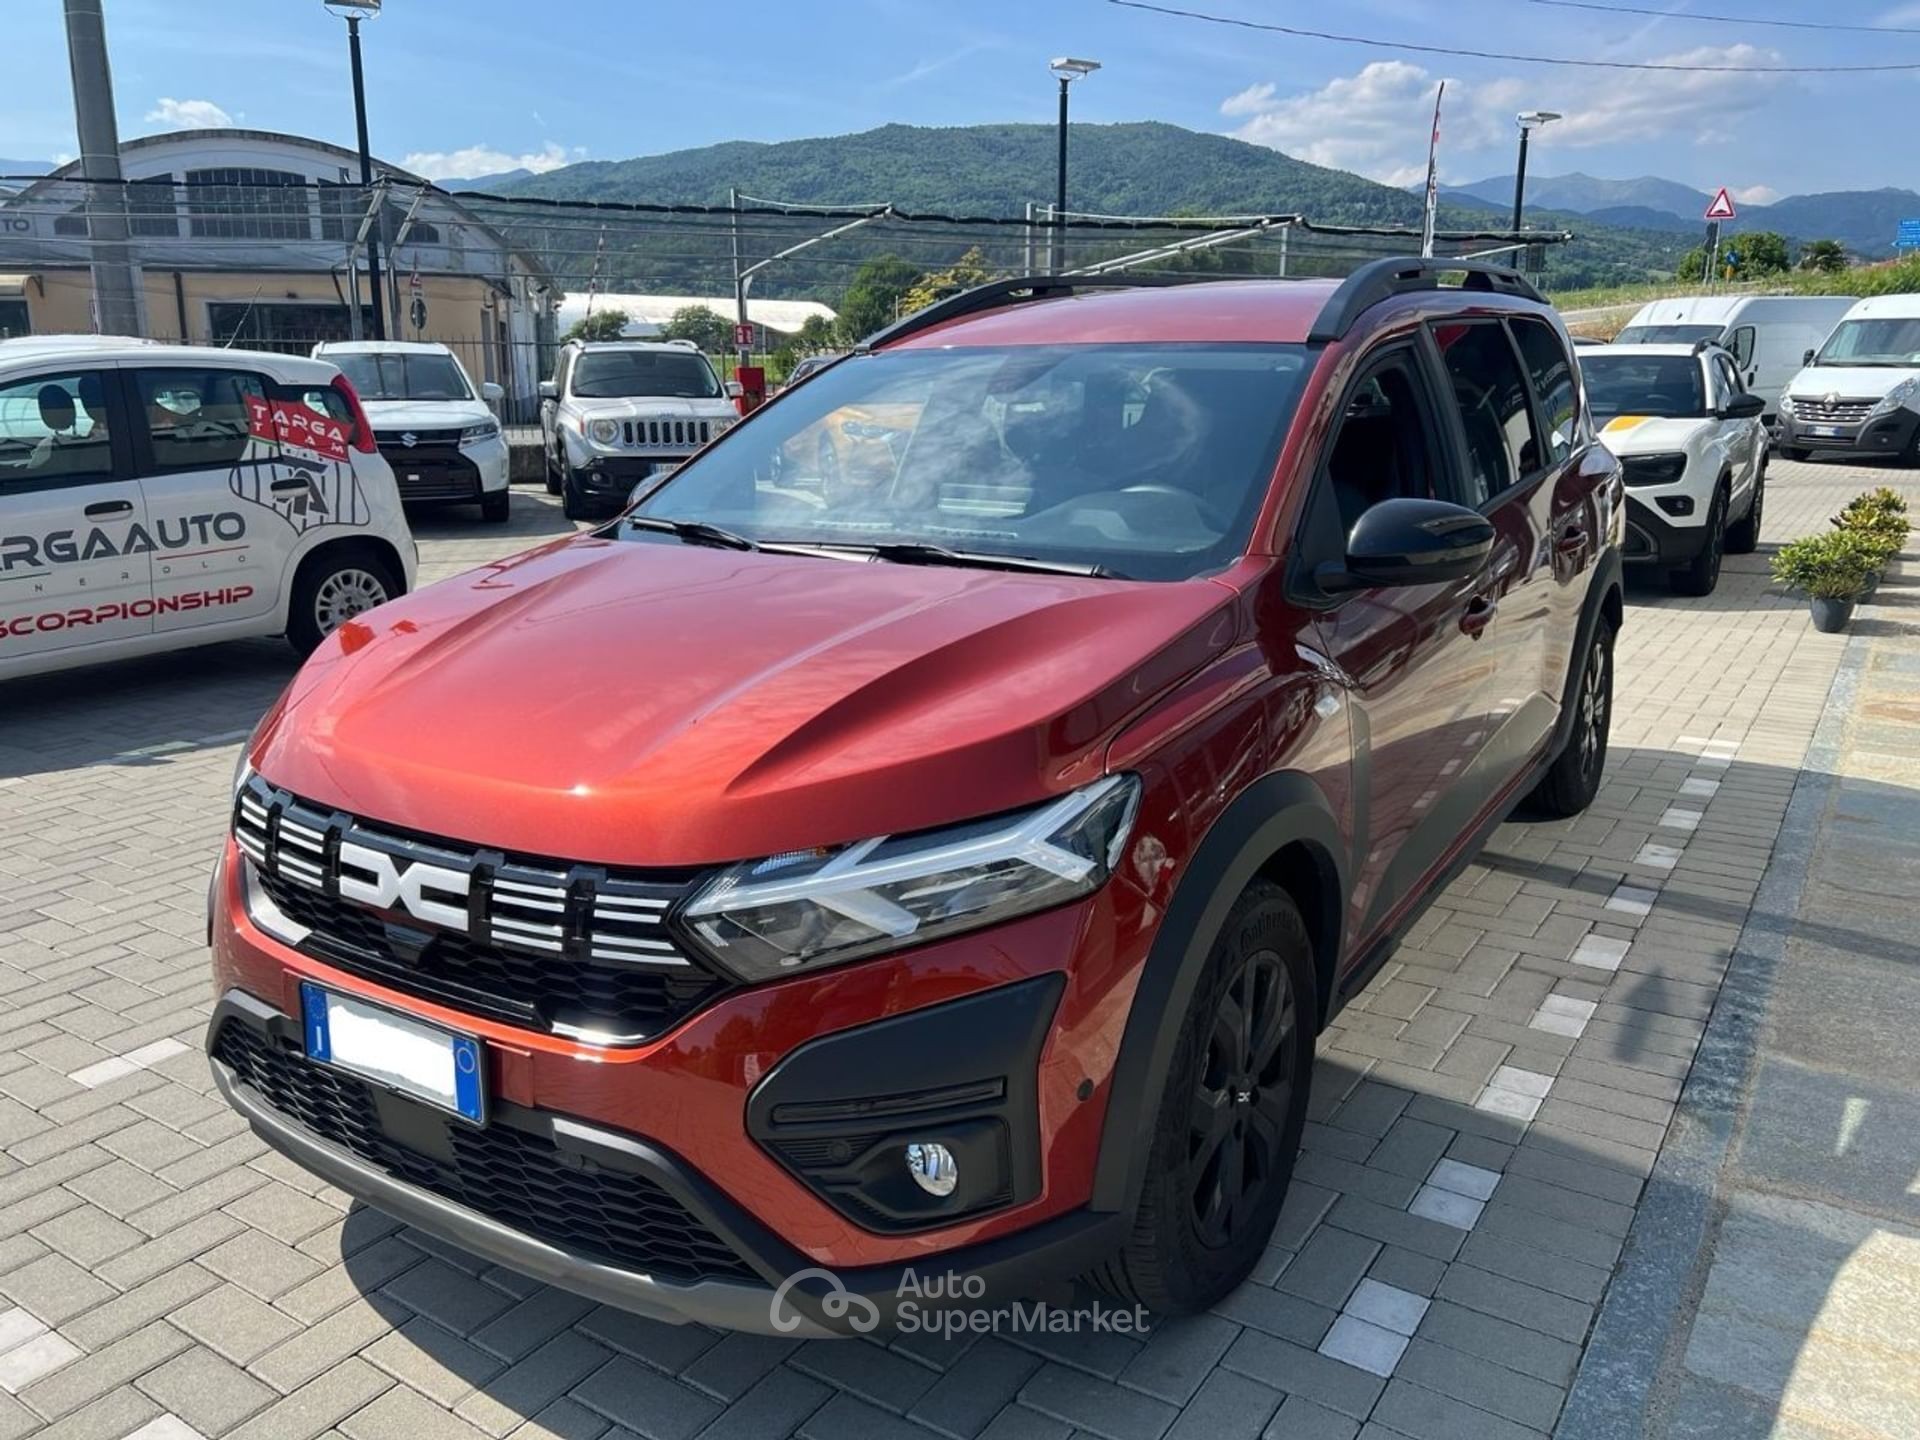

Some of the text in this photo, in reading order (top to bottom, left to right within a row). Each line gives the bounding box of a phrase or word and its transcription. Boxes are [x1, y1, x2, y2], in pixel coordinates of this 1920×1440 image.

[252, 404, 345, 443] TARGA
[254, 421, 345, 454] TEAM
[0, 511, 246, 571] RGAAUTO
